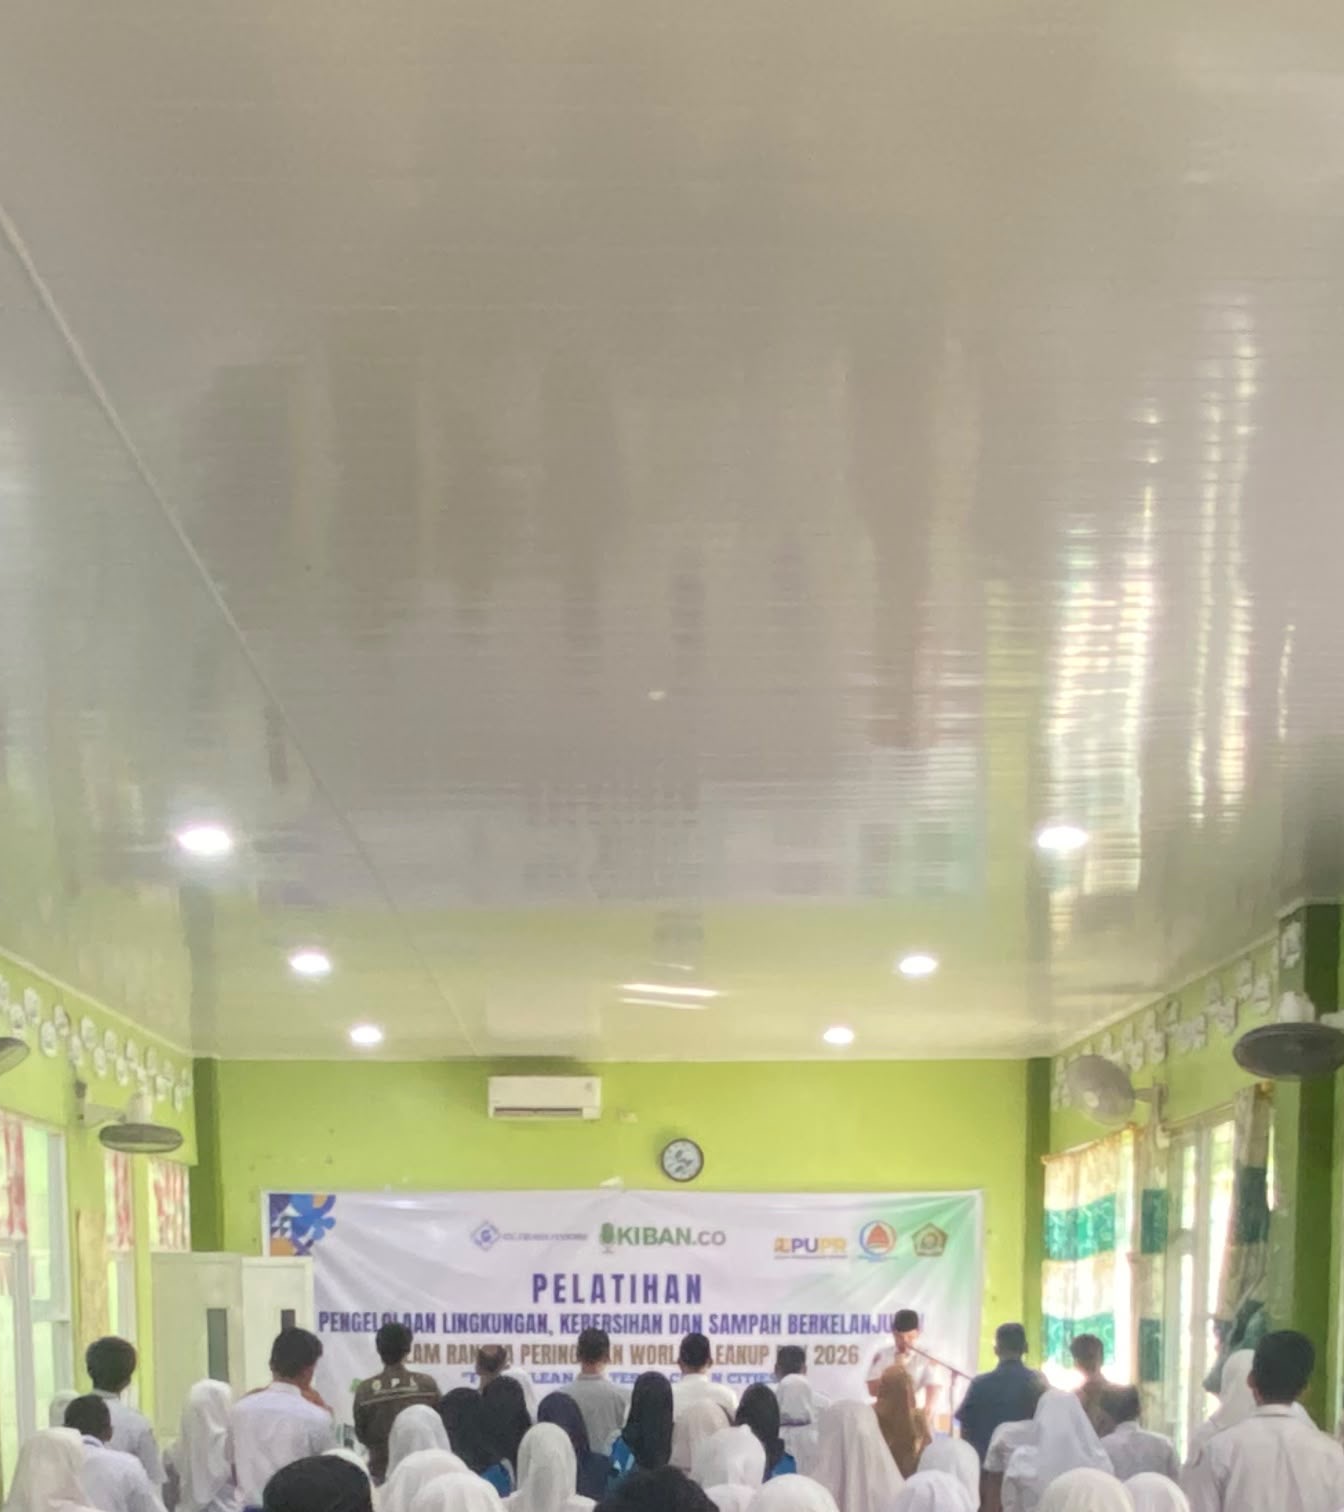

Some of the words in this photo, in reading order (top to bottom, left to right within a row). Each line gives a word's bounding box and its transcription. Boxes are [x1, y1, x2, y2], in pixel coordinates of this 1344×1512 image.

[531, 1273, 702, 1304] PELATIHAN
[442, 1312, 555, 1337] LINGKUNGAN,
[559, 1313, 663, 1335] KEBERSIHAN
[668, 1313, 703, 1335] DAN
[708, 1312, 782, 1335] SAMPAH
[787, 1312, 924, 1335] BERKELANJU
[446, 1343, 514, 1365] RANA
[630, 1344, 678, 1366] WORL
[715, 1344, 771, 1366] EANUP
[814, 1344, 859, 1366] 2026
